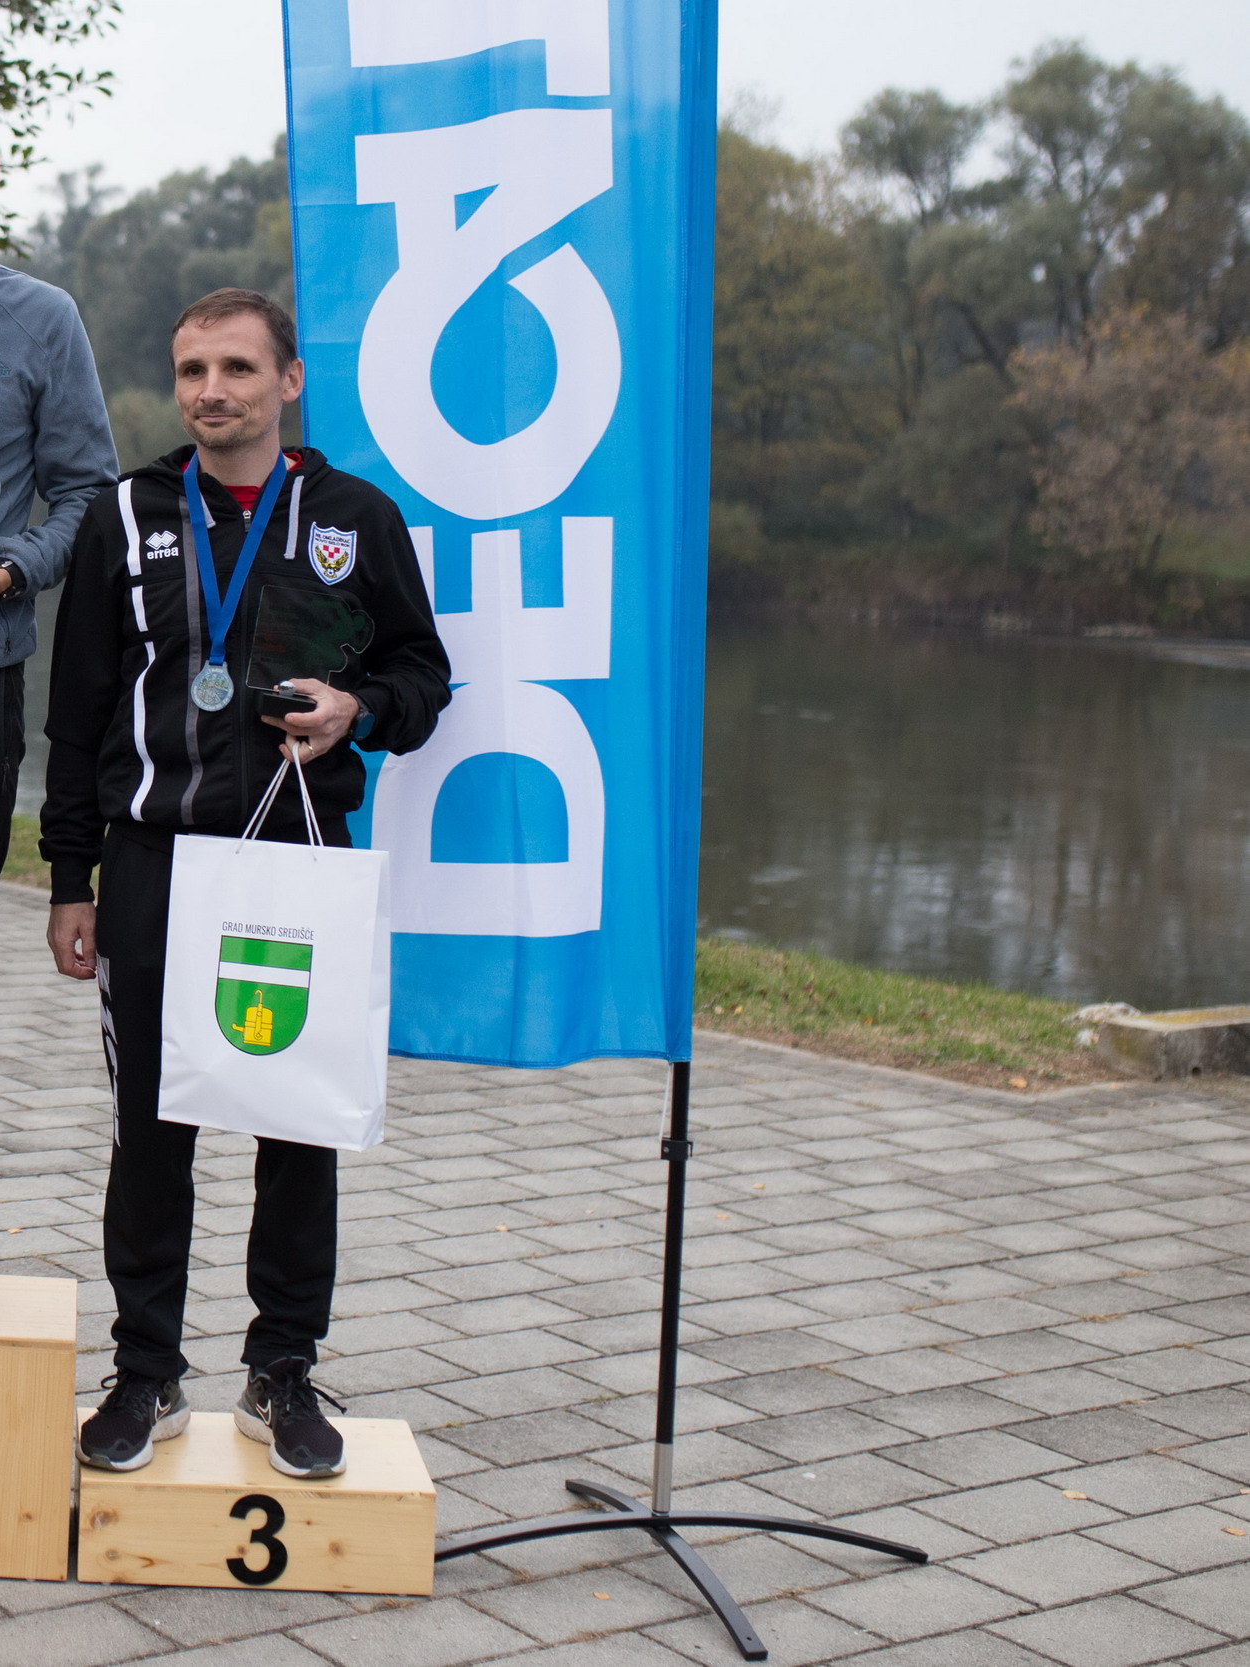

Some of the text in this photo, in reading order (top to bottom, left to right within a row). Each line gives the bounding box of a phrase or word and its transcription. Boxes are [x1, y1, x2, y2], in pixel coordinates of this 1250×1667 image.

[147, 546, 179, 560] errea
[222, 921, 315, 941] GRAD MURSKO SREDIŠĆE
[226, 1493, 286, 1586] 3
